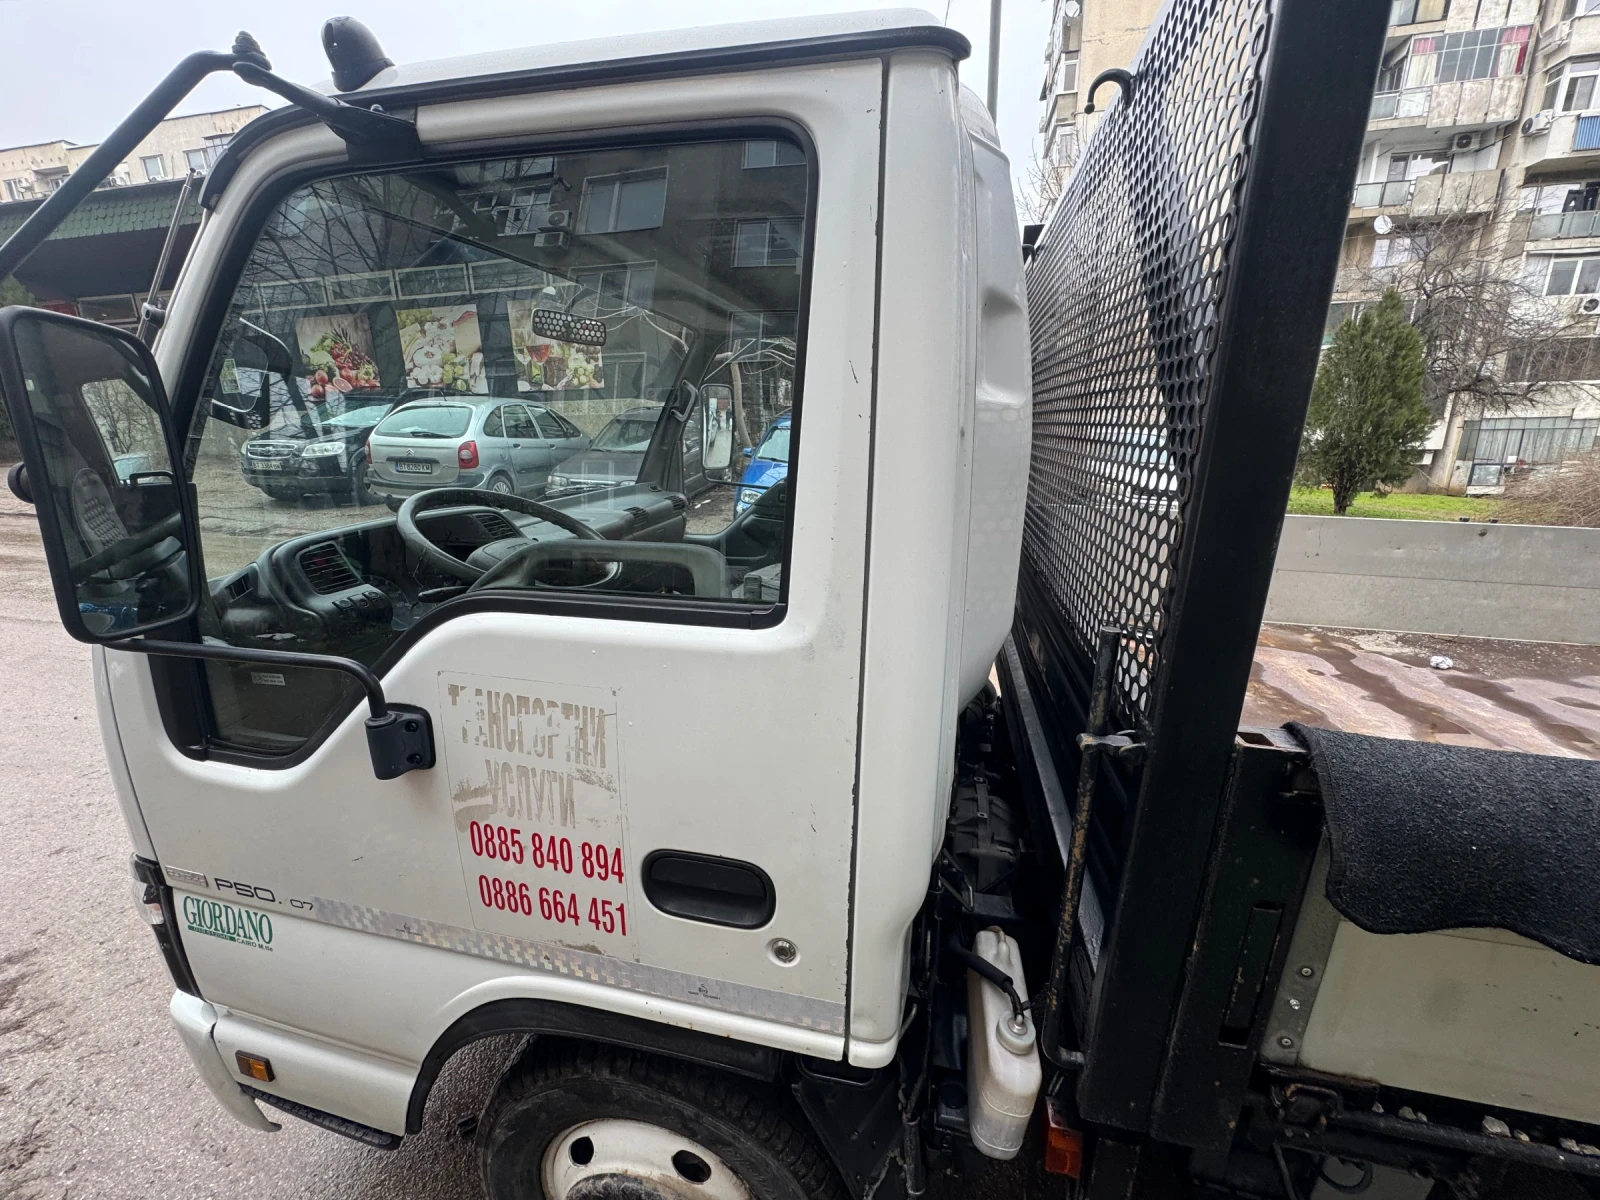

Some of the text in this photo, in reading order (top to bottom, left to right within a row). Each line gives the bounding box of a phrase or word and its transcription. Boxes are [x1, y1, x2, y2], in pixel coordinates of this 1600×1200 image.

[470, 821, 624, 884] 0885 840 894
[183, 896, 274, 944] GIORDANO
[478, 874, 627, 937] 0886 664 451
[236, 937, 257, 948] CAIRO
